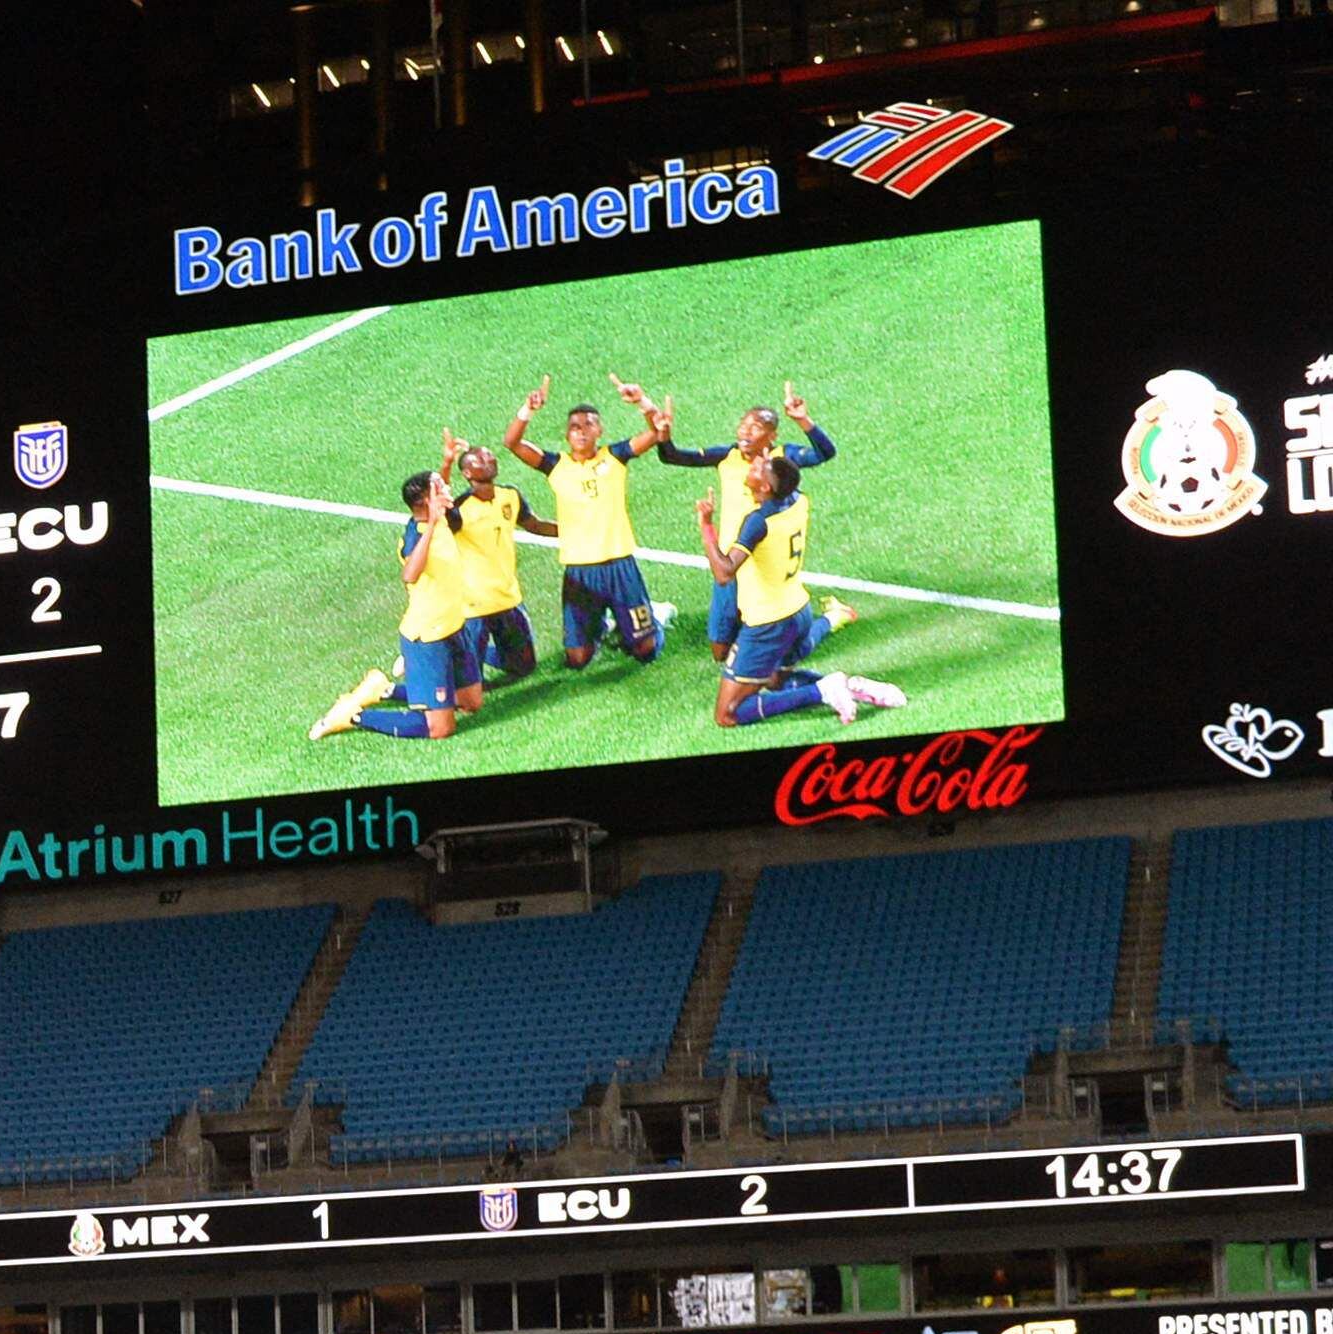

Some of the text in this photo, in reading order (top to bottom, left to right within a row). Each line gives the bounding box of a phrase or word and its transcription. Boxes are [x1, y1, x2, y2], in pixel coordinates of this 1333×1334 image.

[175, 159, 780, 295] Bank of America
[786, 530, 803, 582] 5
[31, 577, 62, 623] 2
[220, 796, 420, 863] Health
[1038, 1144, 1186, 1201] 14:37
[110, 1171, 772, 1251] MEX 1 ECU 2
